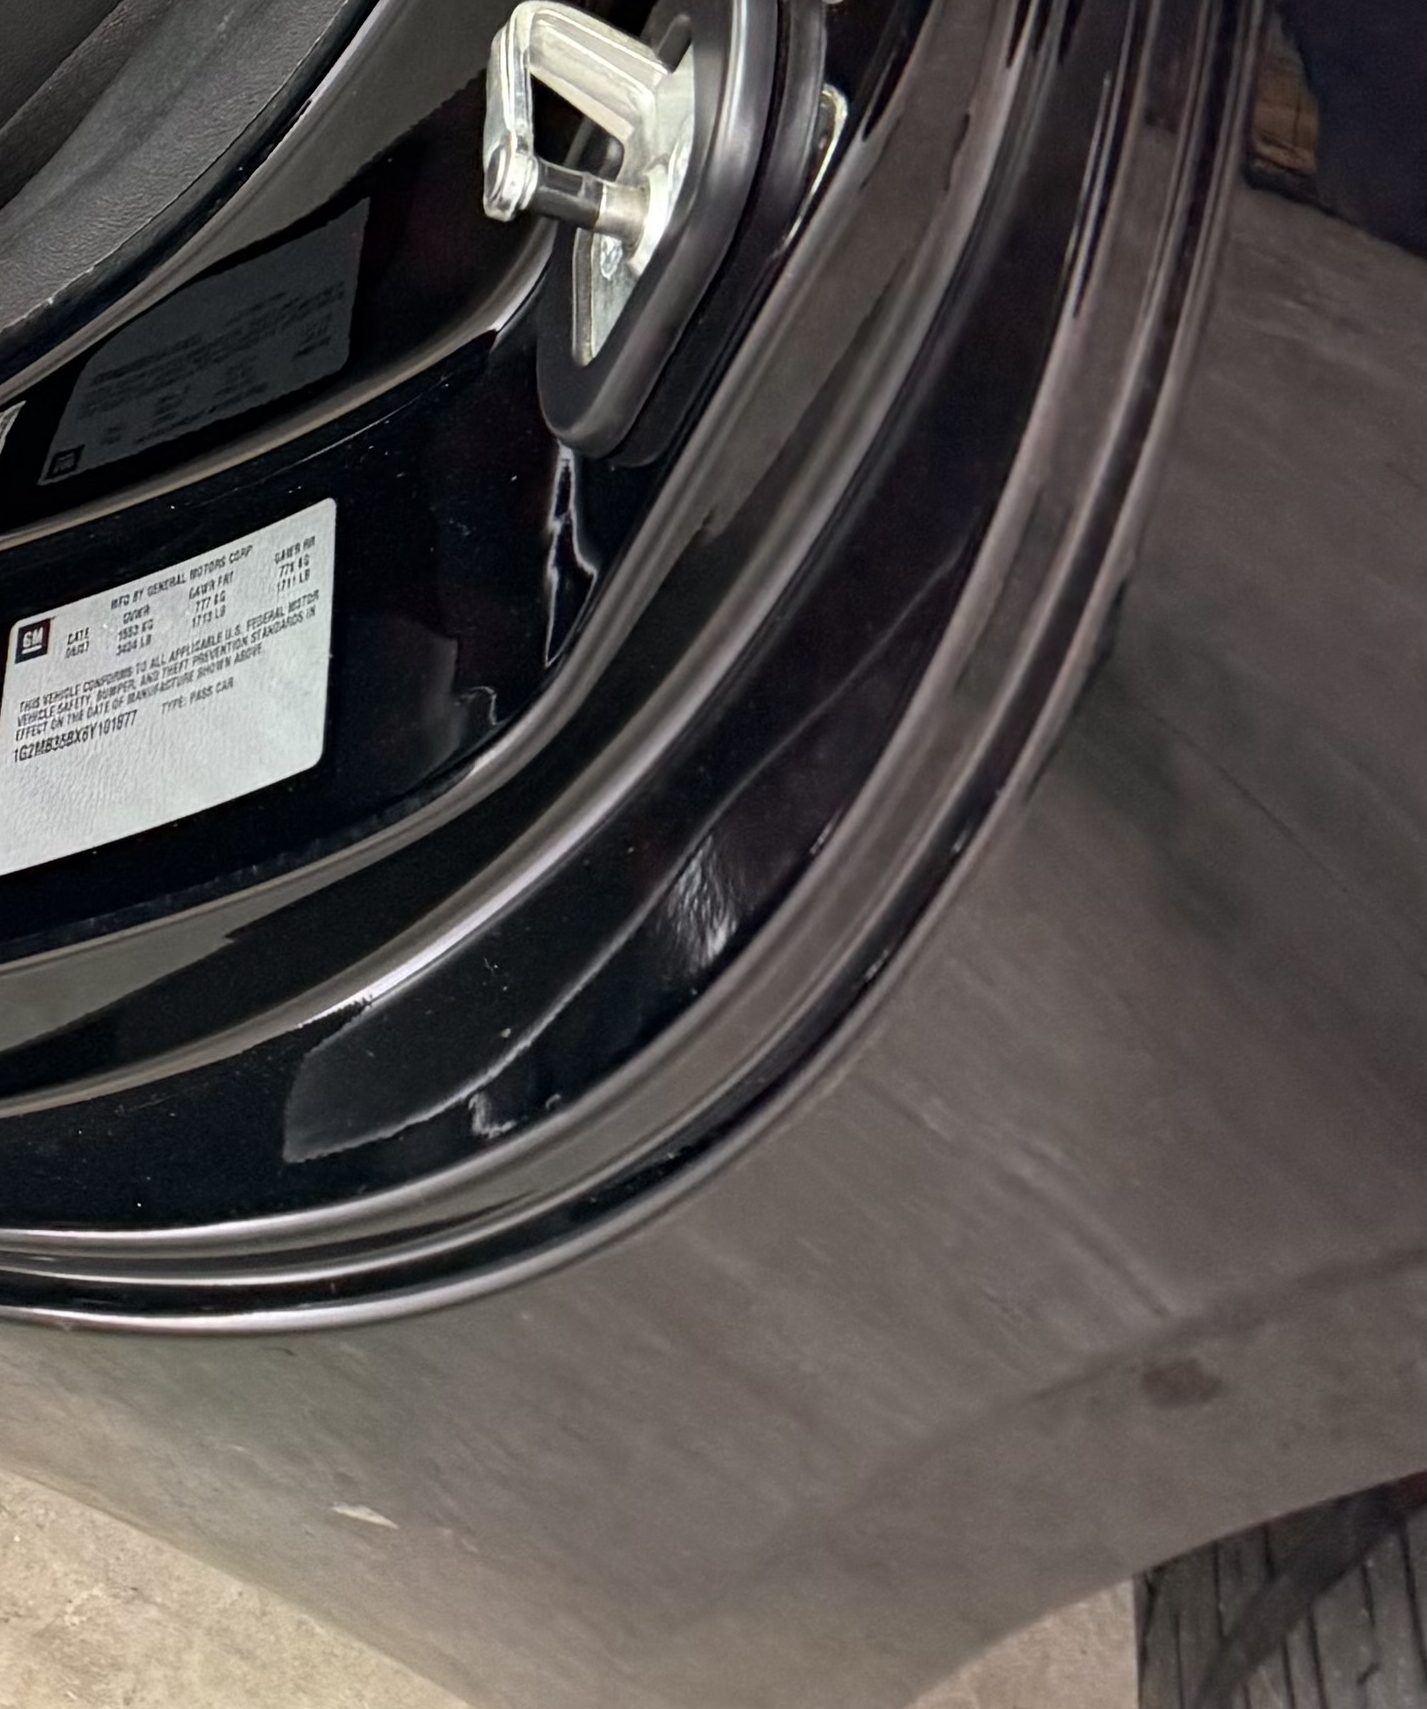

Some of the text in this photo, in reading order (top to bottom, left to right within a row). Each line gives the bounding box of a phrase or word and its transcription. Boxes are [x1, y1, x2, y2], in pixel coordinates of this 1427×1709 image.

[146, 572, 186, 595] GENERAL
[189, 556, 225, 580] MOTORS
[195, 596, 210, 611] 777
[214, 605, 225, 618] LB
[21, 625, 44, 650] GM
[250, 612, 303, 642] STANDARDS
[42, 683, 79, 705] VEHICLE
[150, 652, 164, 668] ALL
[246, 605, 284, 630] FEDERAL
[189, 685, 212, 704] PASS
[216, 676, 233, 693] CAR
[87, 700, 109, 718] DATE
